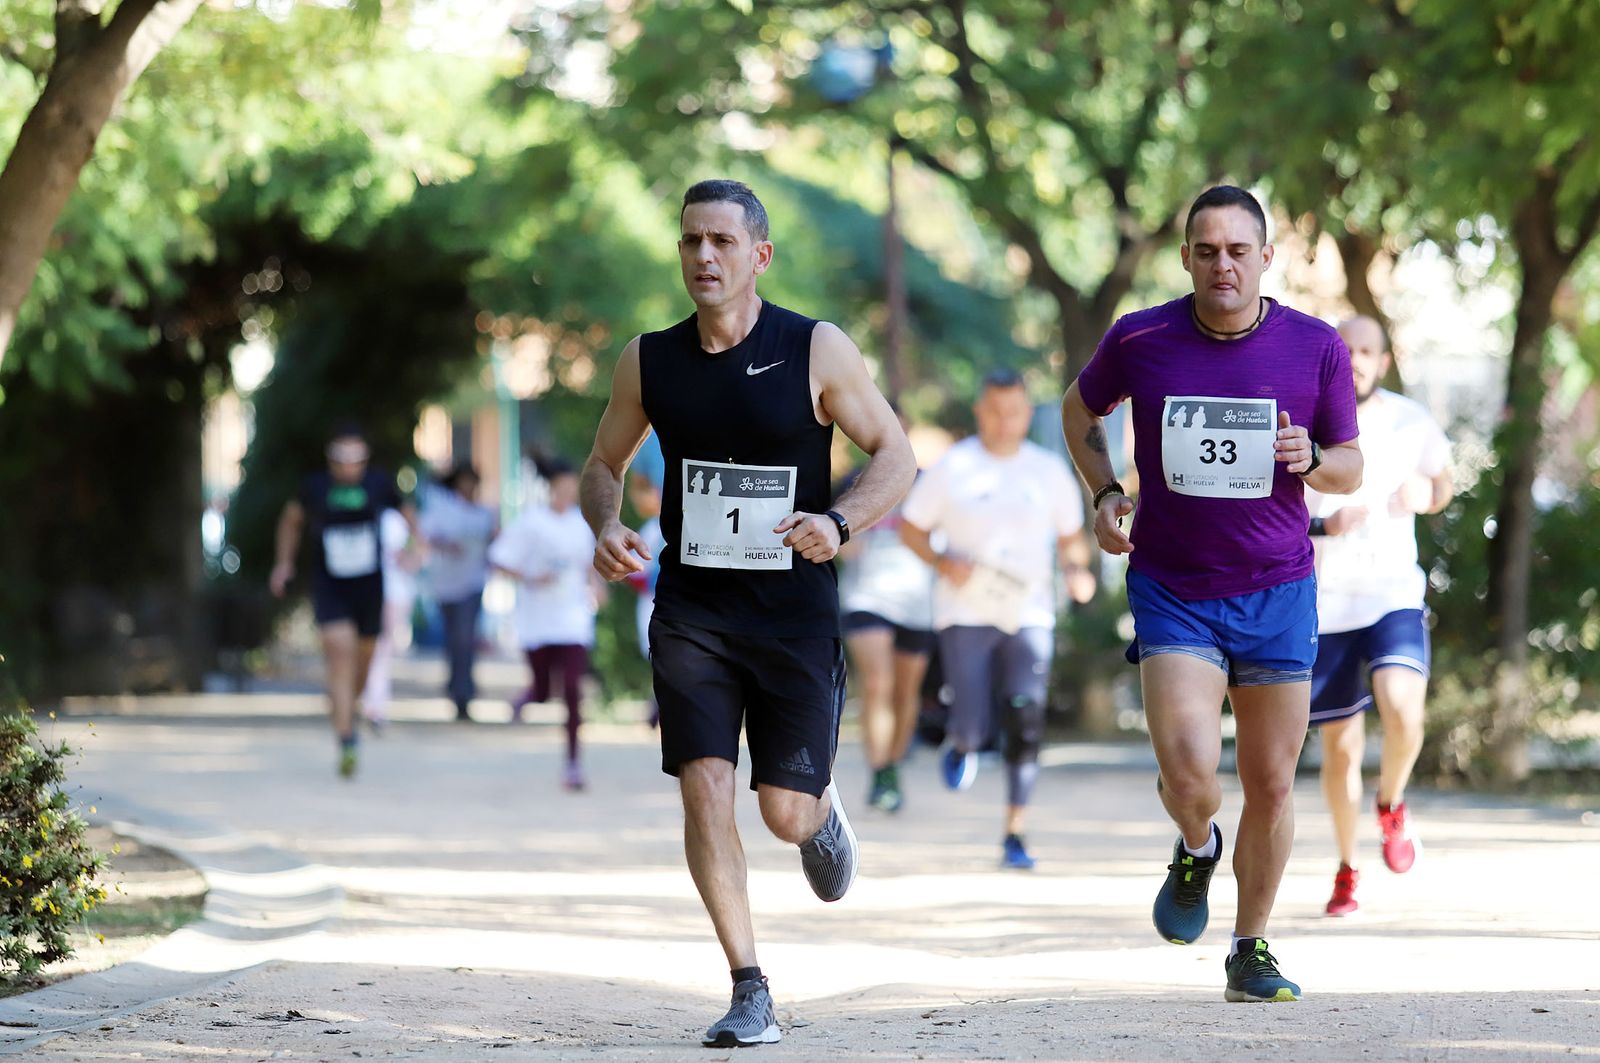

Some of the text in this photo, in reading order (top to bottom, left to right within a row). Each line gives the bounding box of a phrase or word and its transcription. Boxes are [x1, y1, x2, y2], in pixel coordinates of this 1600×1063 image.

[1237, 410, 1249, 418] Que
[1199, 438, 1237, 465] 33
[755, 477, 767, 485] Que
[726, 508, 740, 534] 1
[744, 552, 779, 560] HUELVA
[778, 759, 815, 775] adidas
